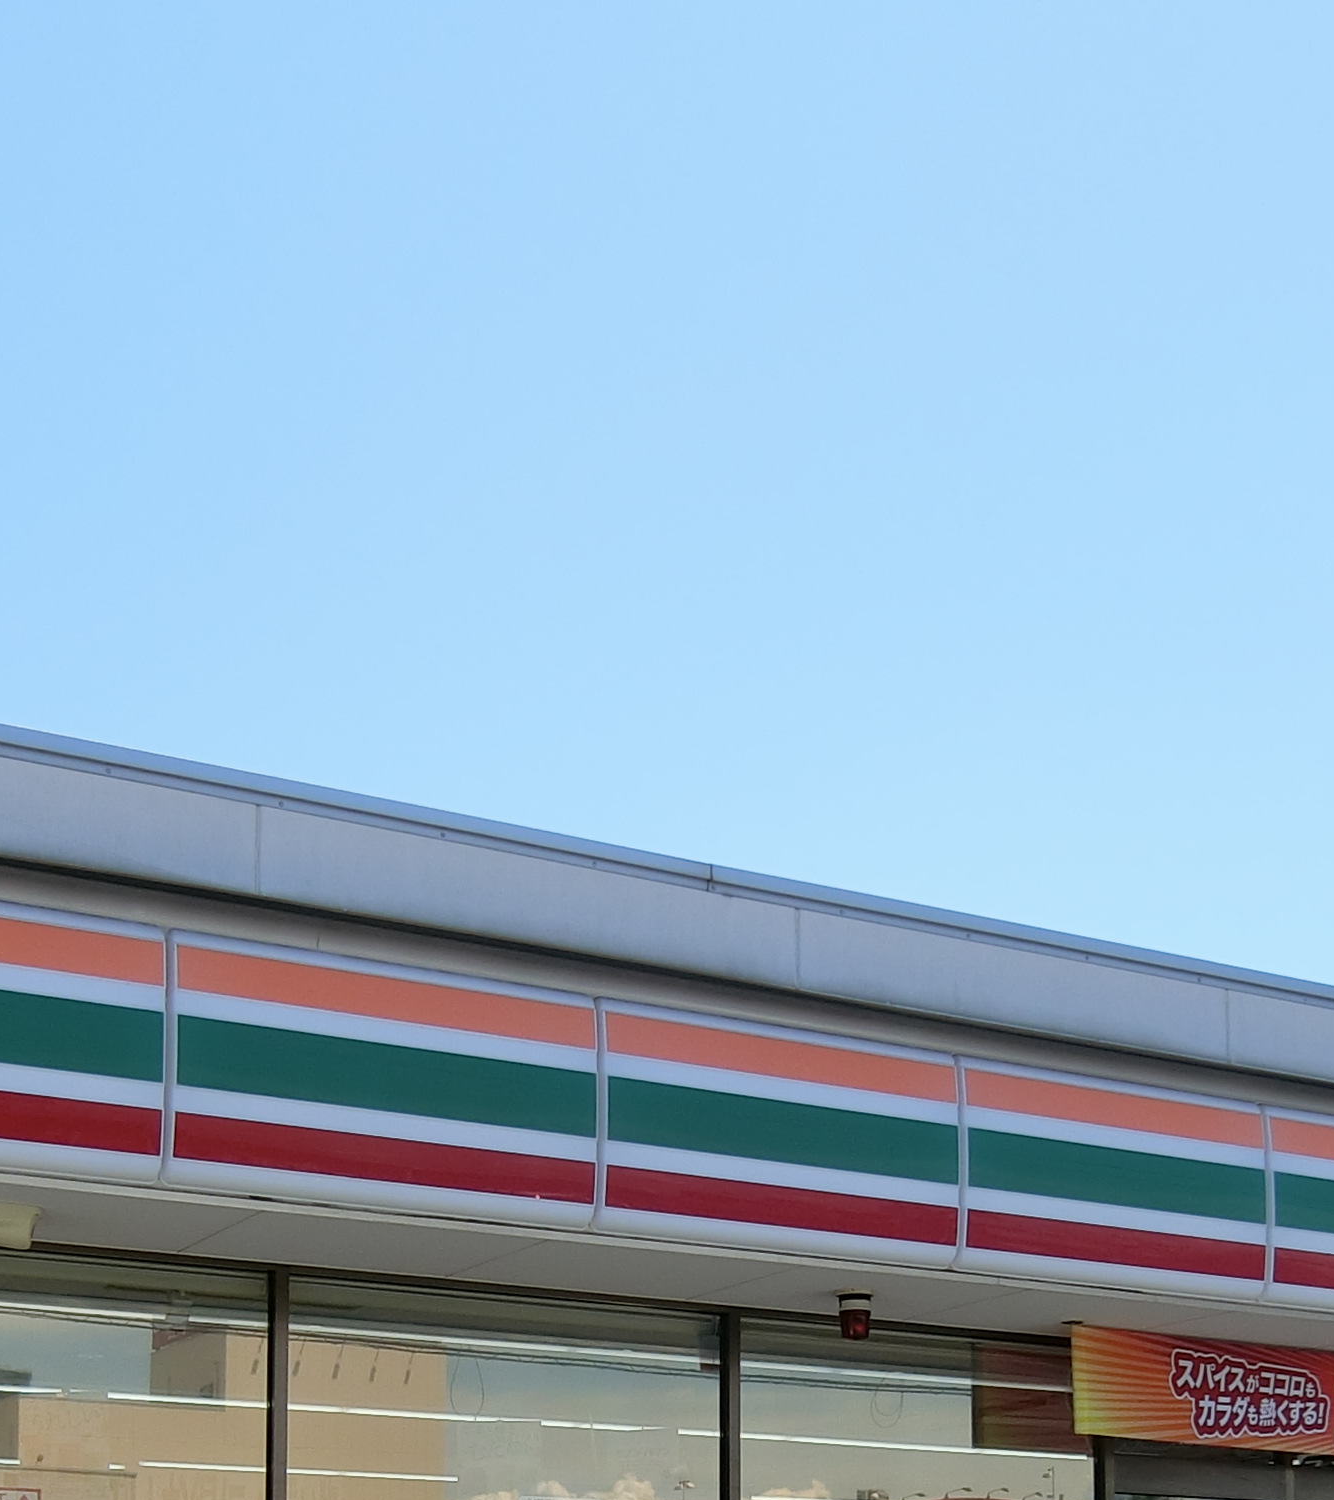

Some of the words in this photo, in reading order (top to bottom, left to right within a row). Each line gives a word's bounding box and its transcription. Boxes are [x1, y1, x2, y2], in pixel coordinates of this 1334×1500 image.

[1175, 1358, 1317, 1396] スパイスがココロも
